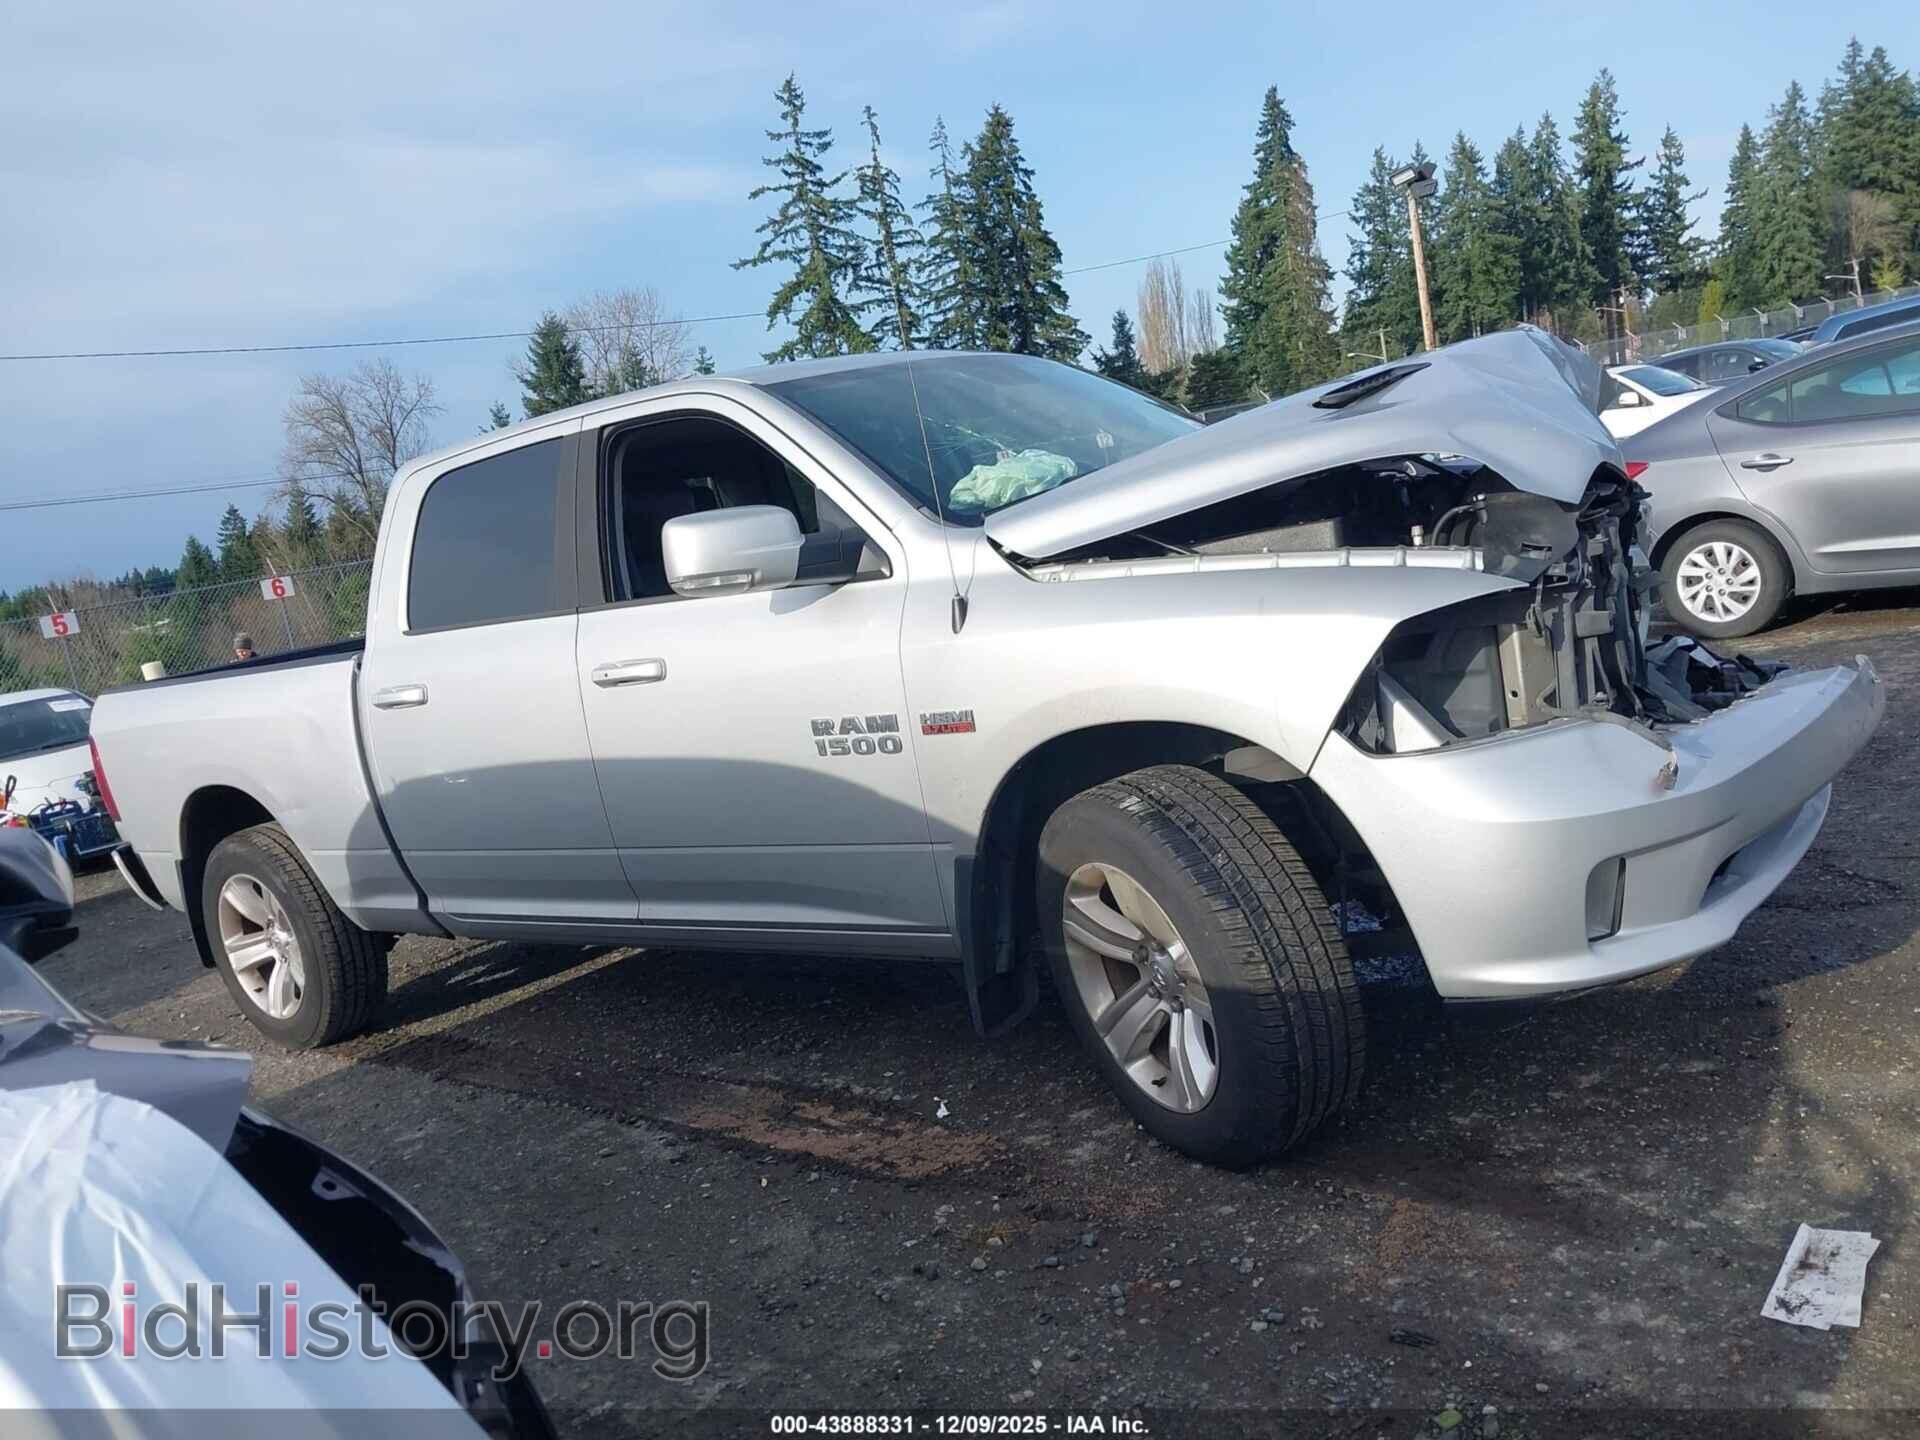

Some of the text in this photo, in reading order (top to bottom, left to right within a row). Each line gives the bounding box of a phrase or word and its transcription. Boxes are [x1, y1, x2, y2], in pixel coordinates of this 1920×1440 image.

[271, 579, 286, 597] 6
[51, 614, 69, 635] 5
[811, 714, 899, 736] RAM
[815, 735, 903, 757] 1500
